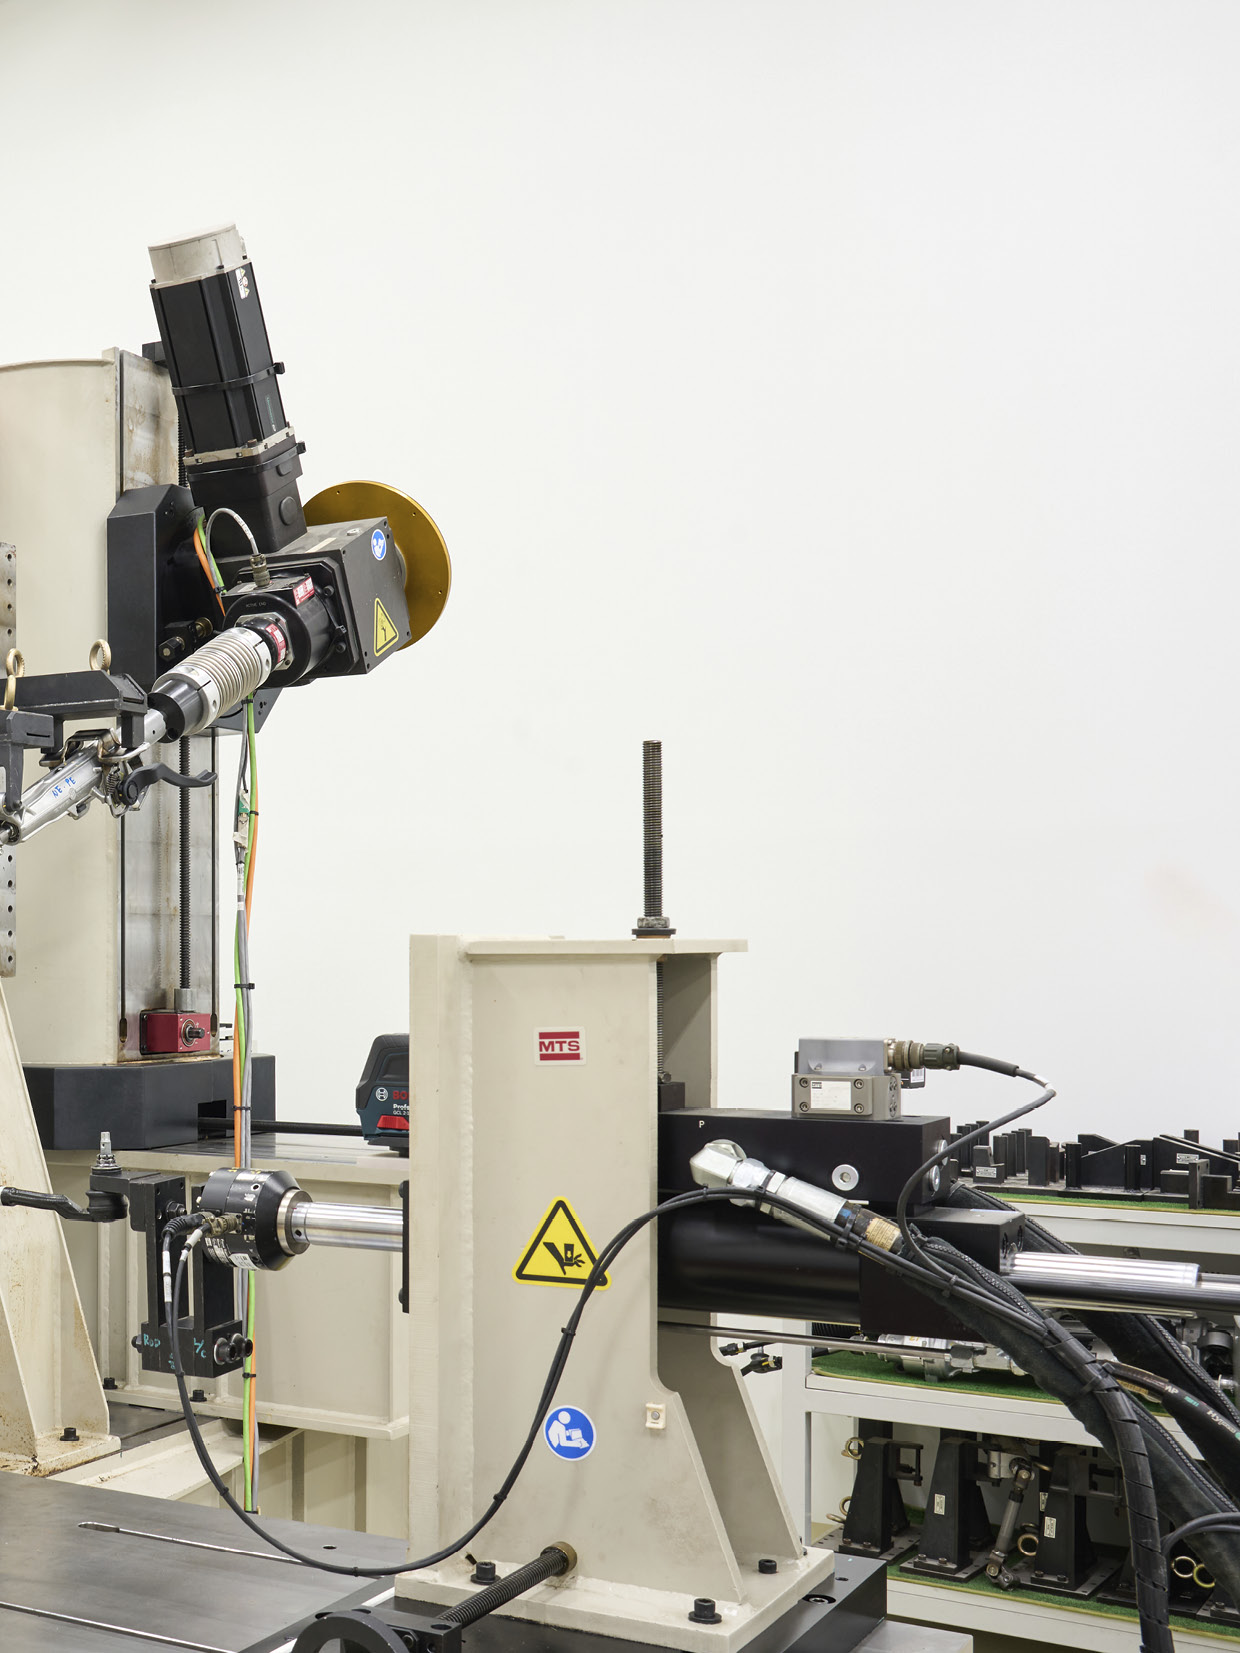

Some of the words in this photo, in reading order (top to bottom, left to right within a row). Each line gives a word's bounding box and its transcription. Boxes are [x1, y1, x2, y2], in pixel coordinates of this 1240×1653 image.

[539, 1040, 580, 1052] MTS
[393, 1090, 409, 1100] BO
[698, 1120, 705, 1128] P
